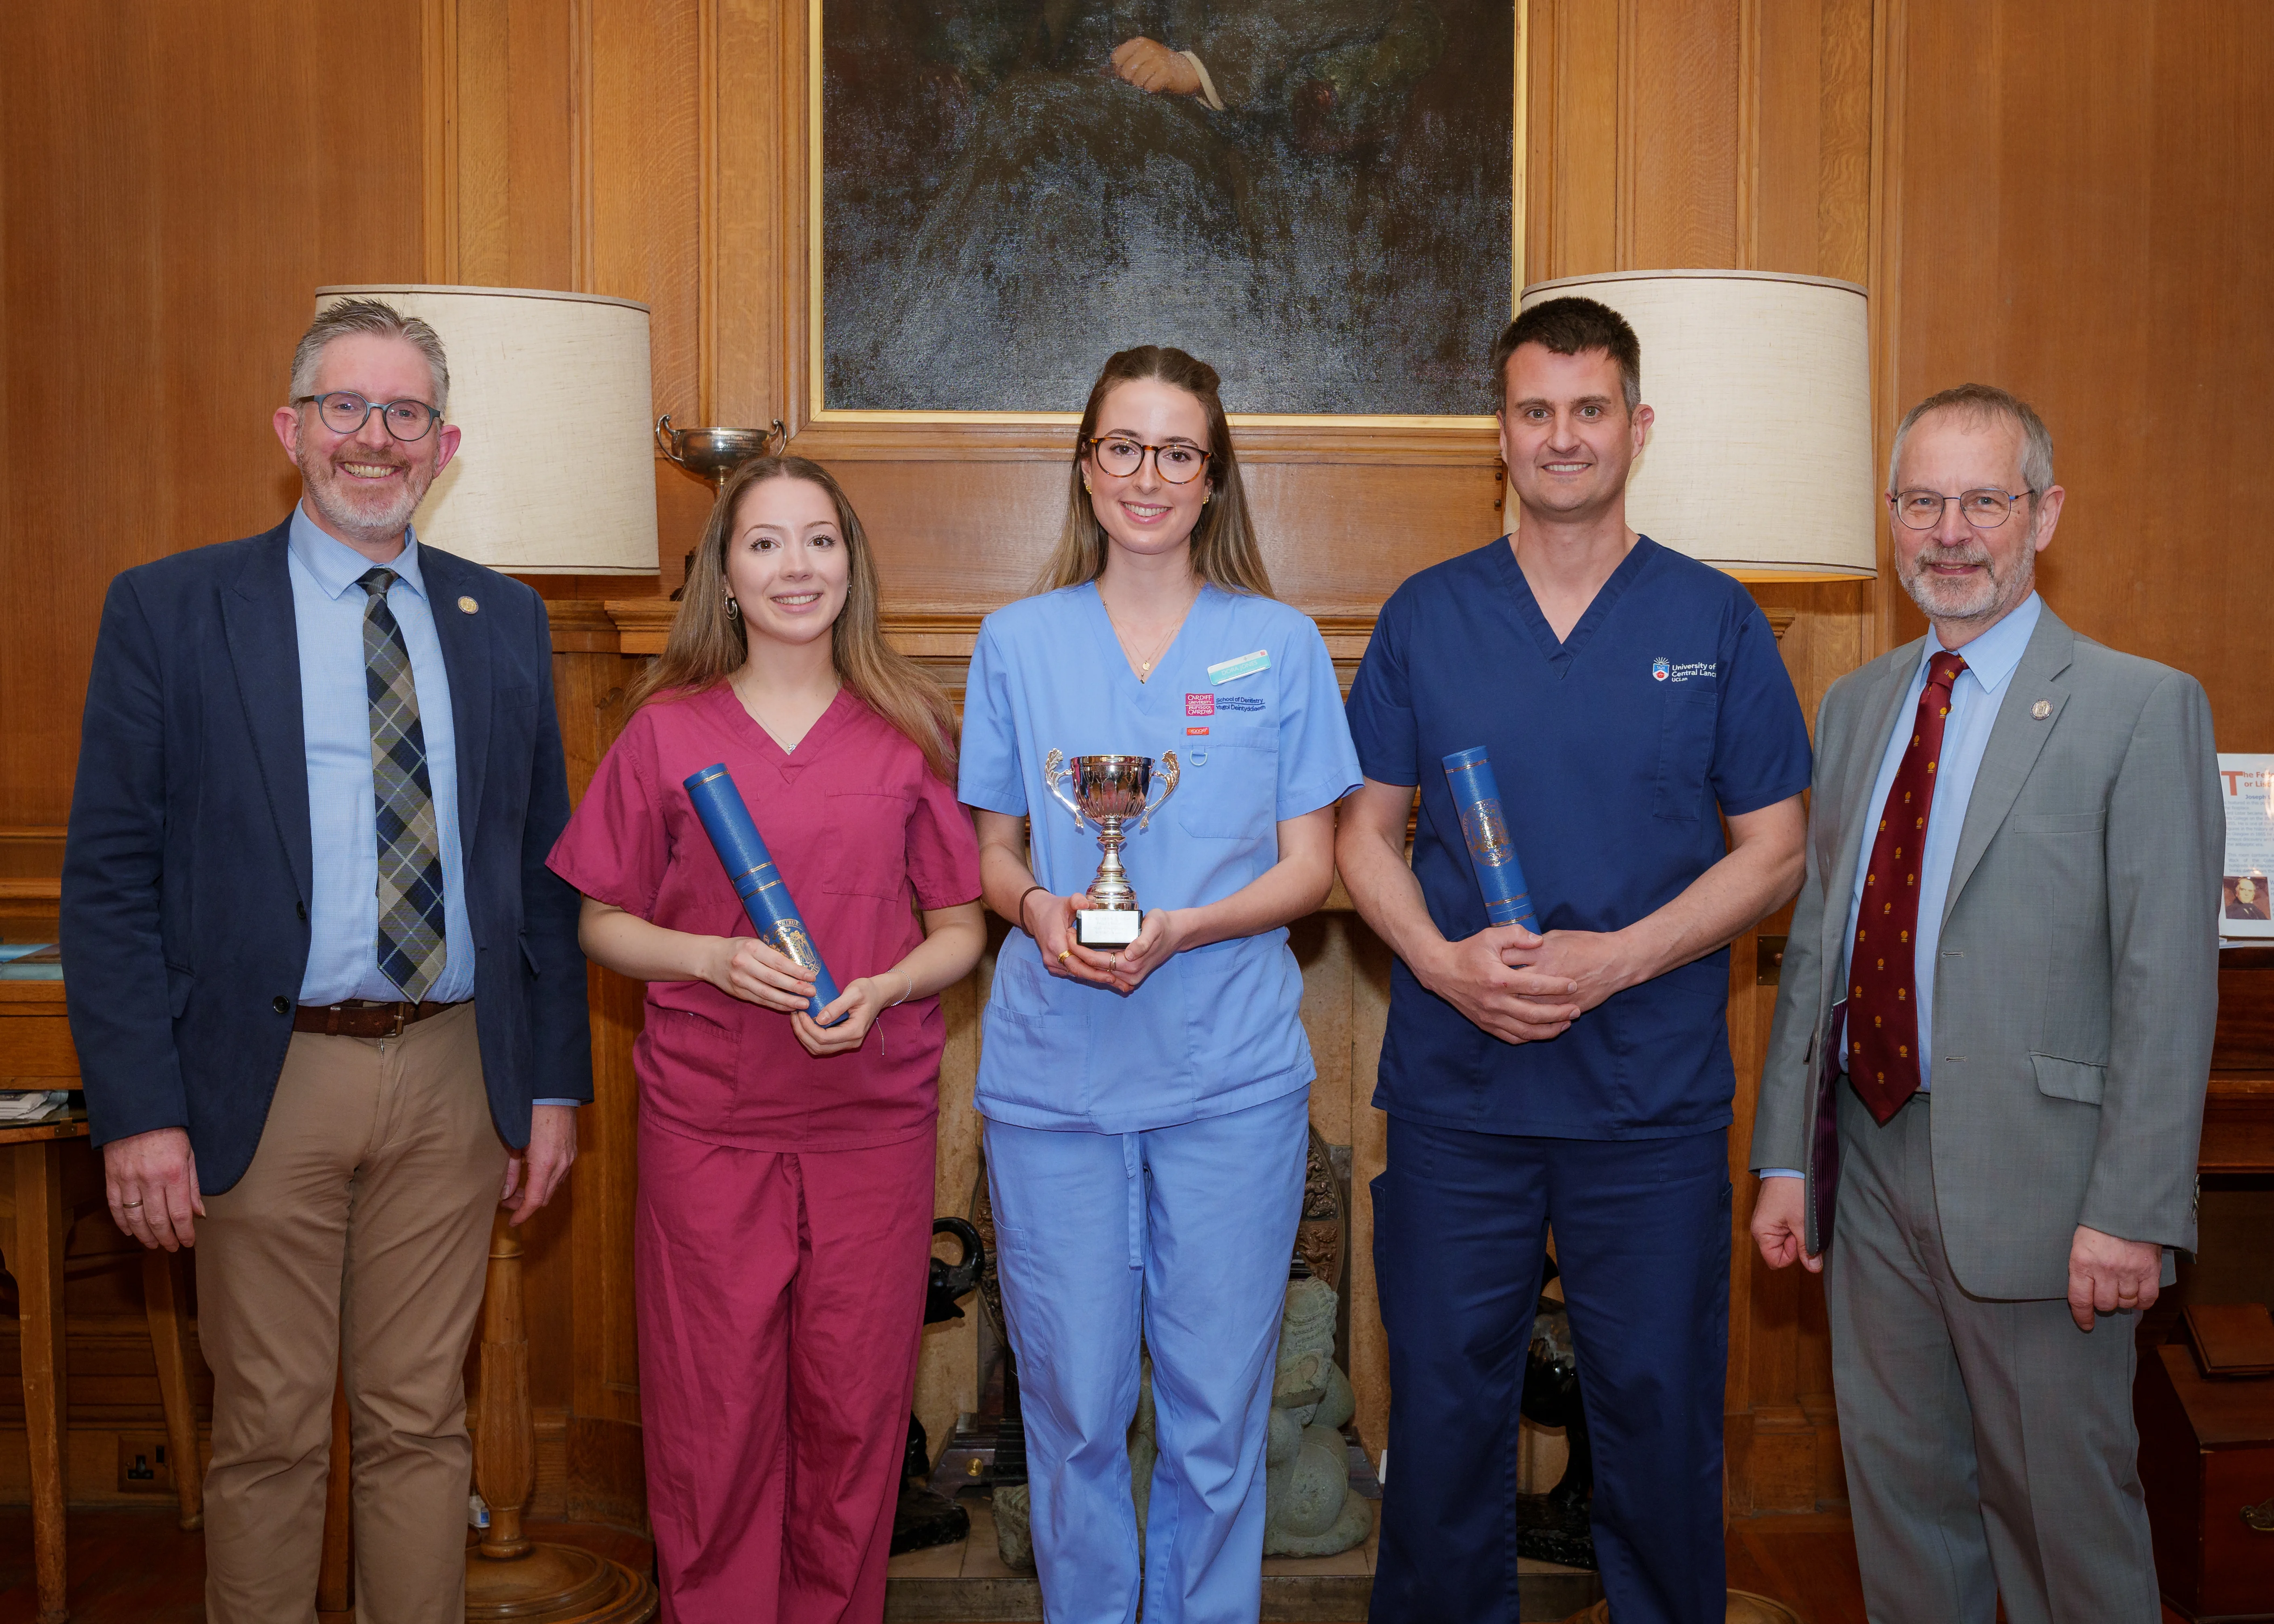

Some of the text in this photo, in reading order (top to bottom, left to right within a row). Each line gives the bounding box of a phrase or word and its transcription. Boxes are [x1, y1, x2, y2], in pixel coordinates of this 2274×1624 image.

[1221, 667, 1239, 675] DORA
[1240, 661, 1257, 671] JONES
[1672, 662, 1707, 671] University
[1672, 669, 1716, 678] Central Lanc
